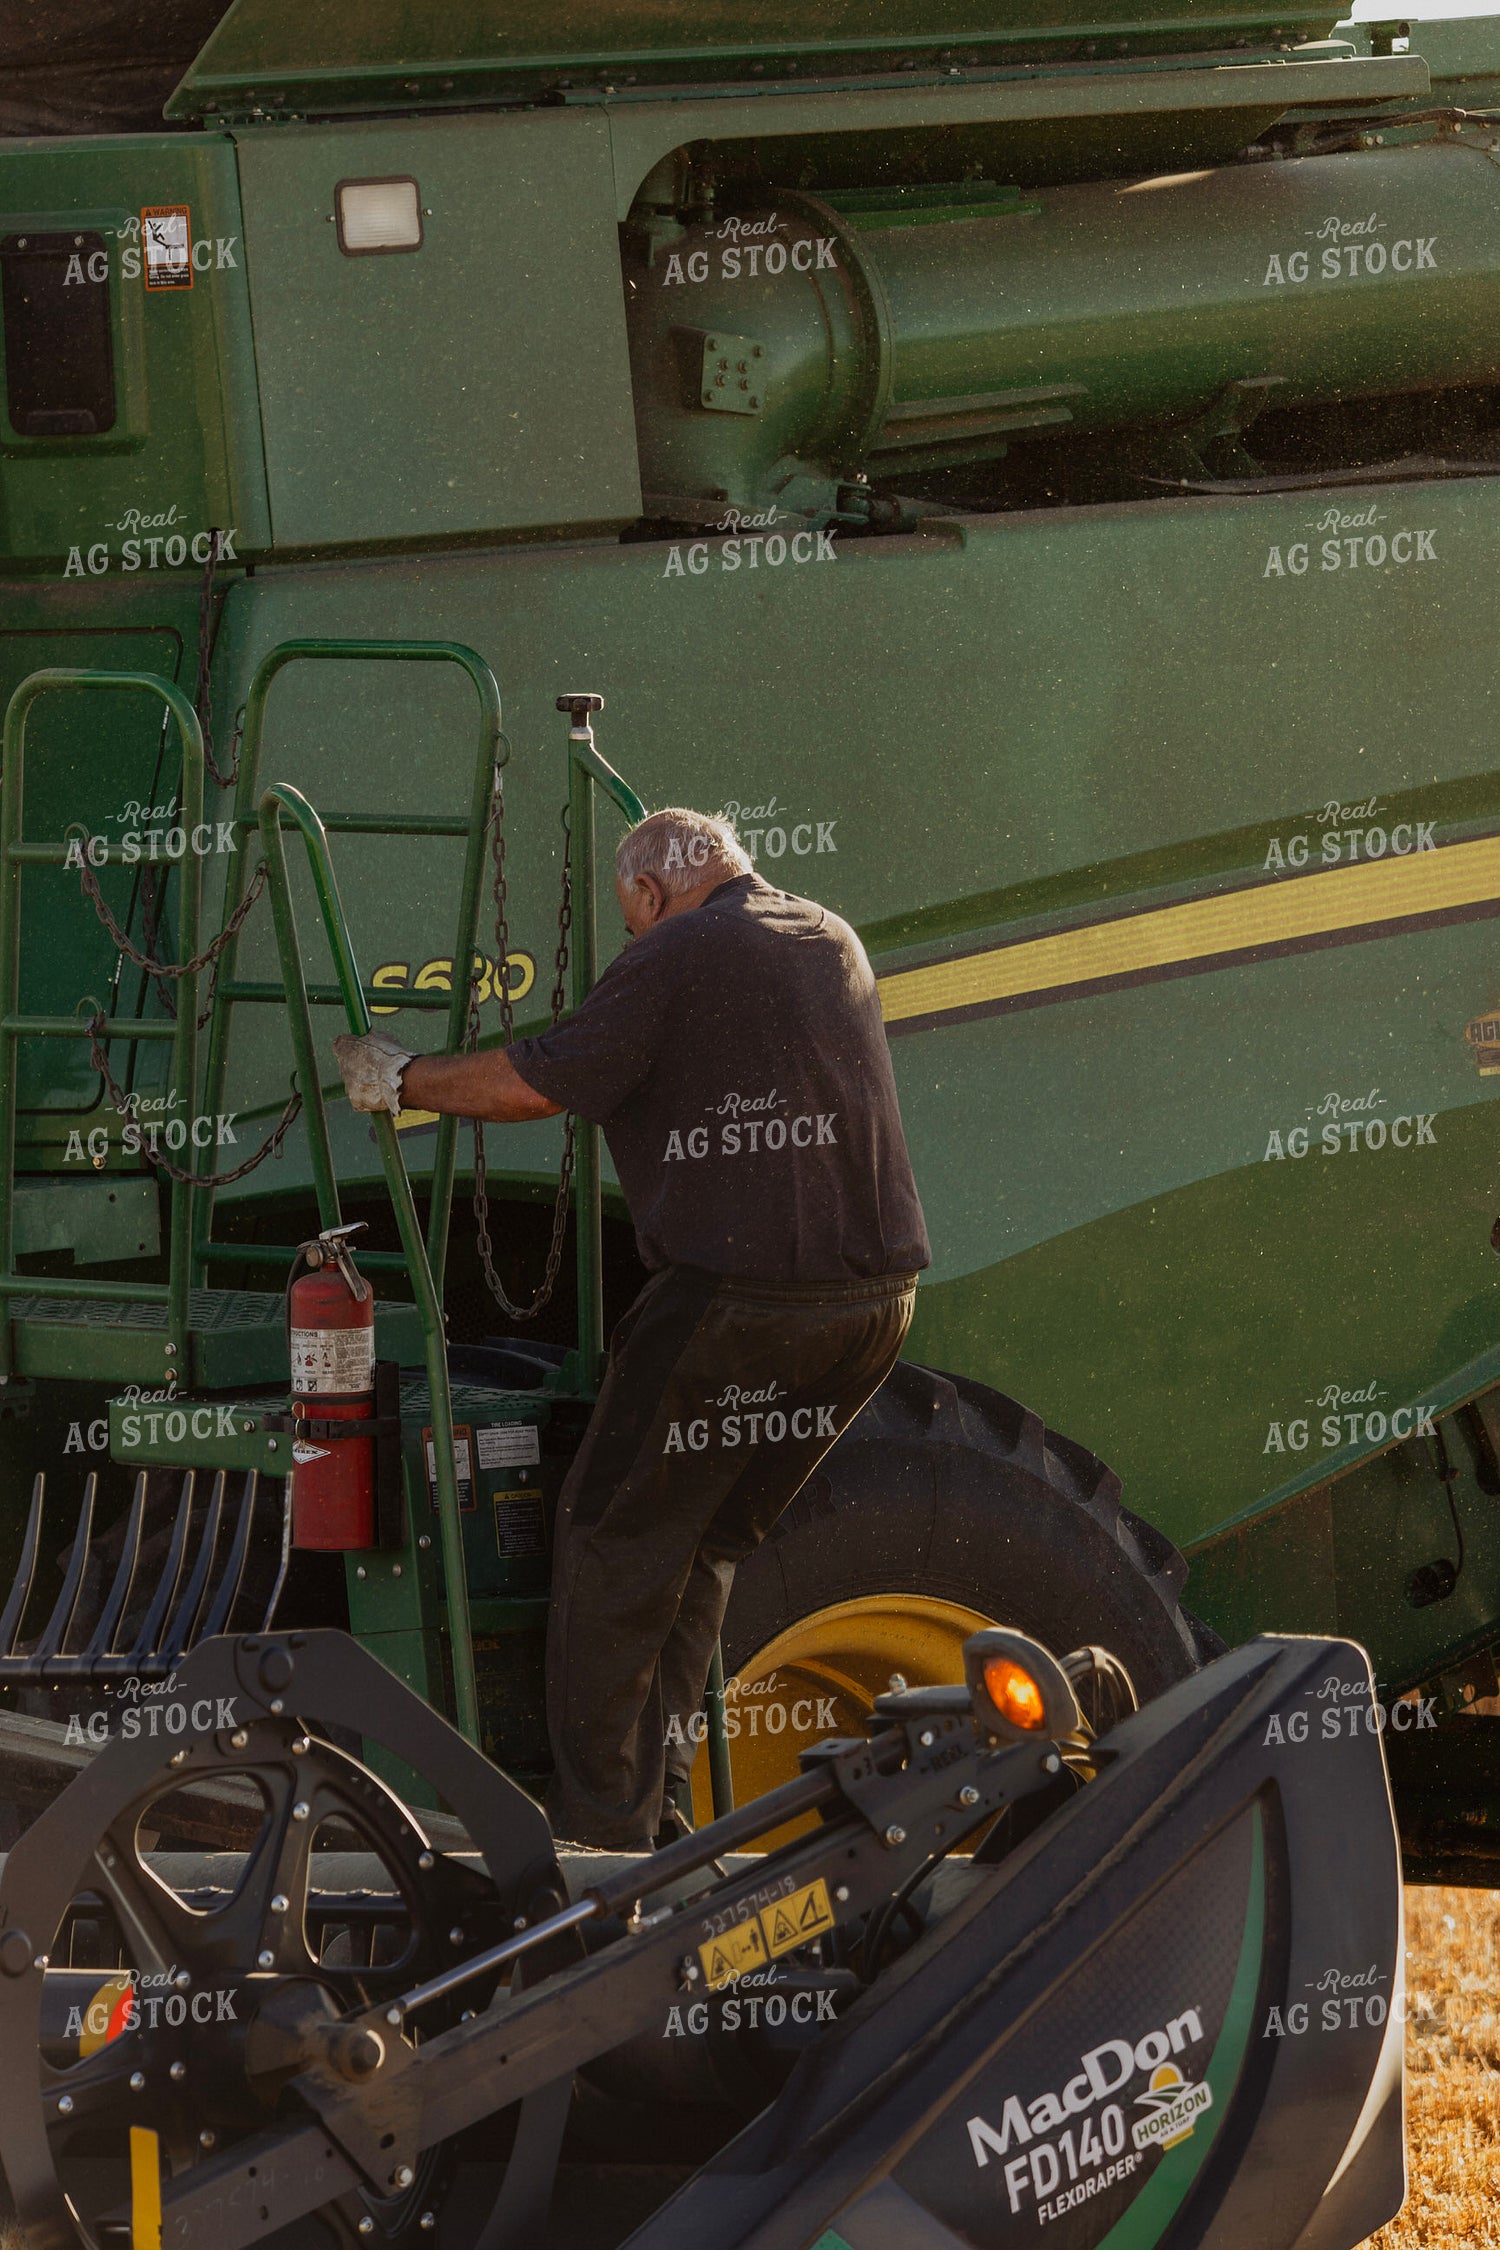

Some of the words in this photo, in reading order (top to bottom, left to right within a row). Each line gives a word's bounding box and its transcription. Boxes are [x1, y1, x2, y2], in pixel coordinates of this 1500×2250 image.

[966, 2008, 1204, 2168] MacDon
[1136, 2088, 1207, 2142] HORIZON
[1004, 2103, 1126, 2214] FD140
